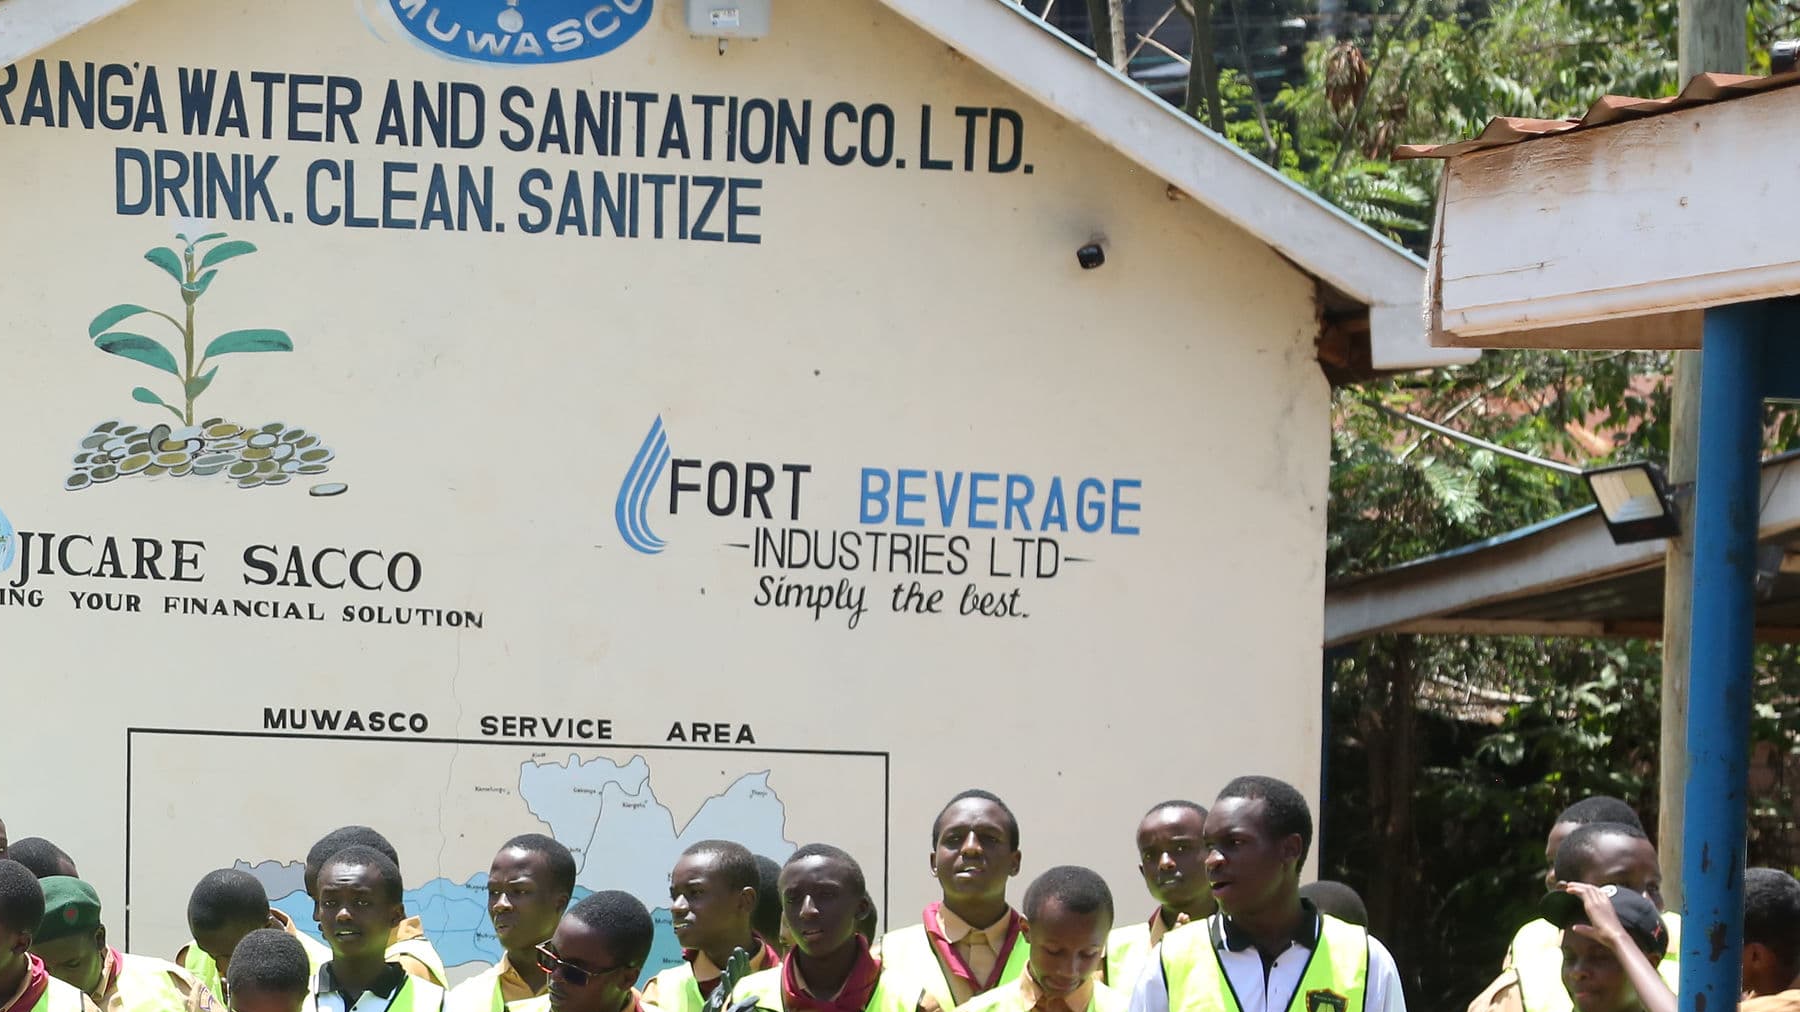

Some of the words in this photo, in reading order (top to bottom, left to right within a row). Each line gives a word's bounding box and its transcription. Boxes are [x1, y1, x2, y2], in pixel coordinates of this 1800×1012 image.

[178, 67, 363, 144] WATER
[375, 79, 485, 148] AND
[499, 86, 812, 165] SANITATION
[824, 102, 906, 169] CO.
[920, 104, 1034, 174] LTD.
[115, 146, 293, 223] DRINK.
[306, 158, 505, 233] CLEAN.
[518, 168, 762, 244] SANITIZE
[670, 458, 812, 521] FORT
[859, 467, 1142, 535] BEVERAGE
[242, 543, 422, 593] SACCO
[754, 526, 970, 575] INDUSTRIES
[990, 537, 1060, 580] LTD
[69, 590, 142, 613] YOUR
[163, 596, 325, 621] FINANCIAL
[341, 604, 485, 629] SOLUTION
[754, 576, 869, 629] Simply
[892, 581, 943, 614] the
[959, 586, 1030, 619] best.
[263, 707, 429, 734] MUWASCO
[480, 716, 614, 741] SERVICE
[666, 721, 757, 745] AREA
